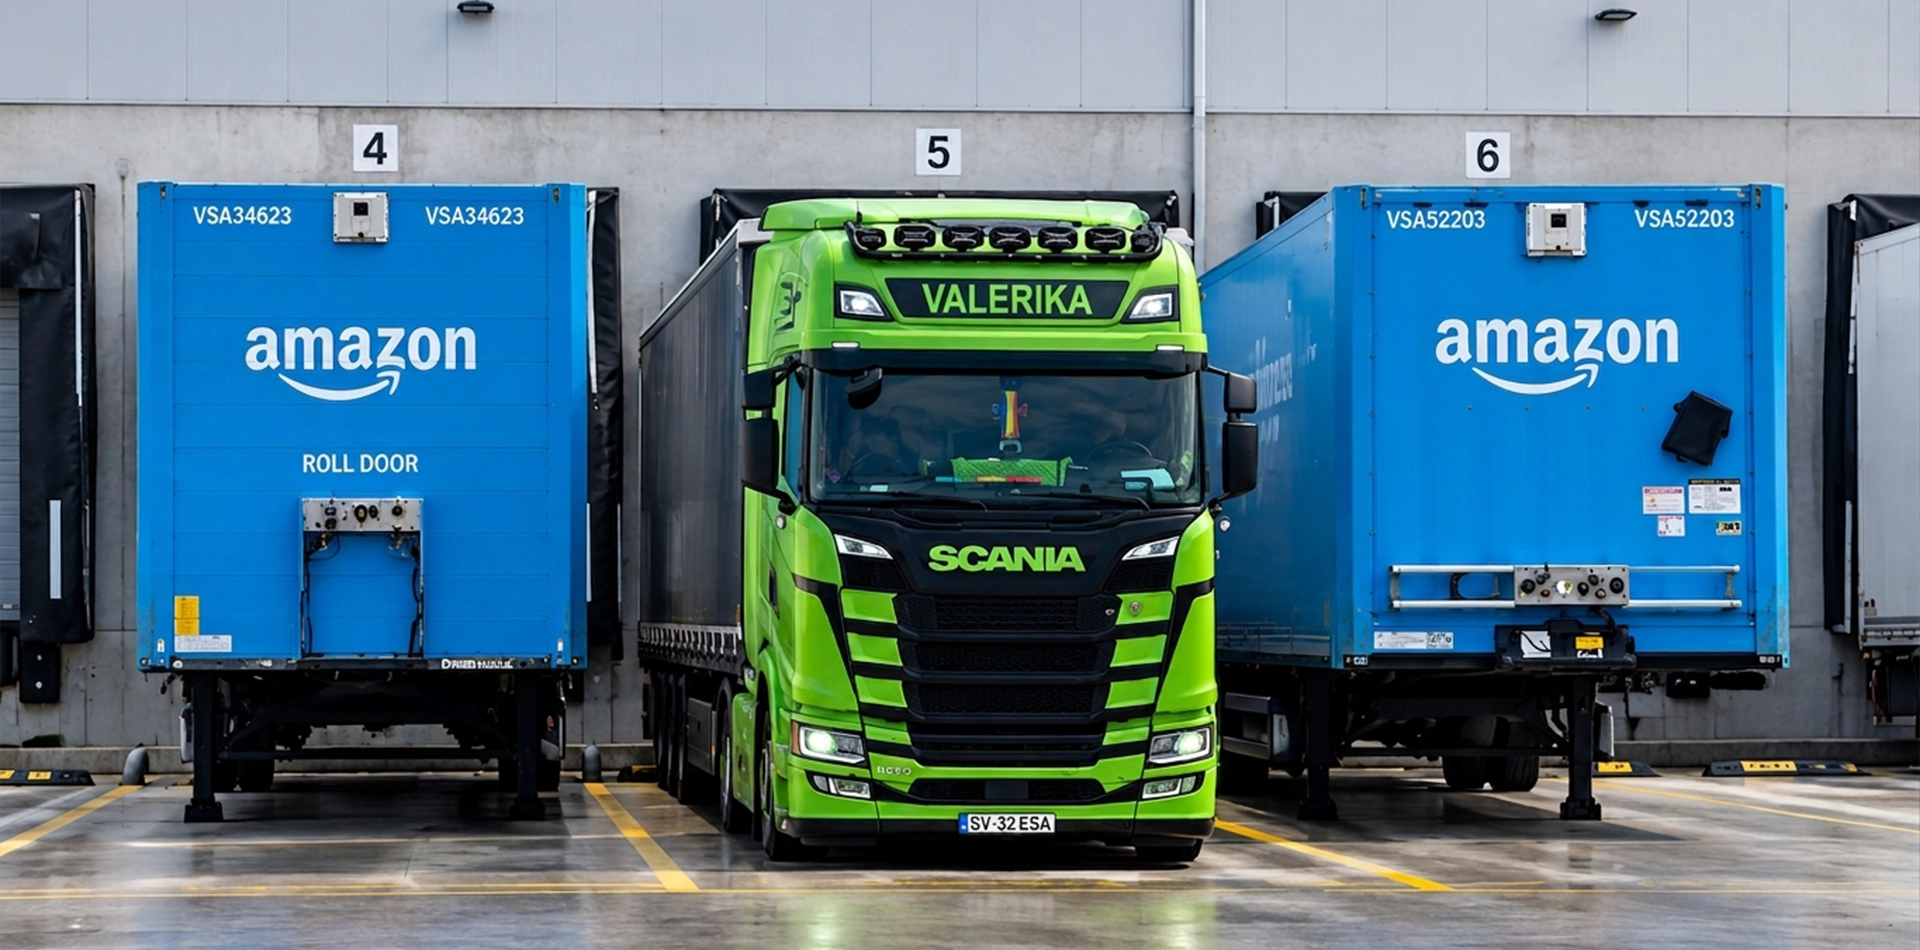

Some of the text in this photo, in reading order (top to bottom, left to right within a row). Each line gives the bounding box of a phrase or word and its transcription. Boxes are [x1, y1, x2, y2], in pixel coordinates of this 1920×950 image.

[362, 131, 388, 167] 4
[928, 135, 950, 169] 5
[1476, 138, 1500, 173] 6
[193, 205, 292, 225] VSA34623
[425, 205, 524, 225] VSA34623
[1386, 209, 1486, 229] VSA52203
[1634, 208, 1735, 228] VSA52203
[921, 283, 1093, 315] VALERIKA
[245, 326, 477, 373] amazon
[1435, 318, 1679, 365] amazon
[302, 453, 419, 473] ROLL DOOR
[928, 544, 1086, 573] SCANIA
[970, 815, 1051, 831] SV-32 ESA
